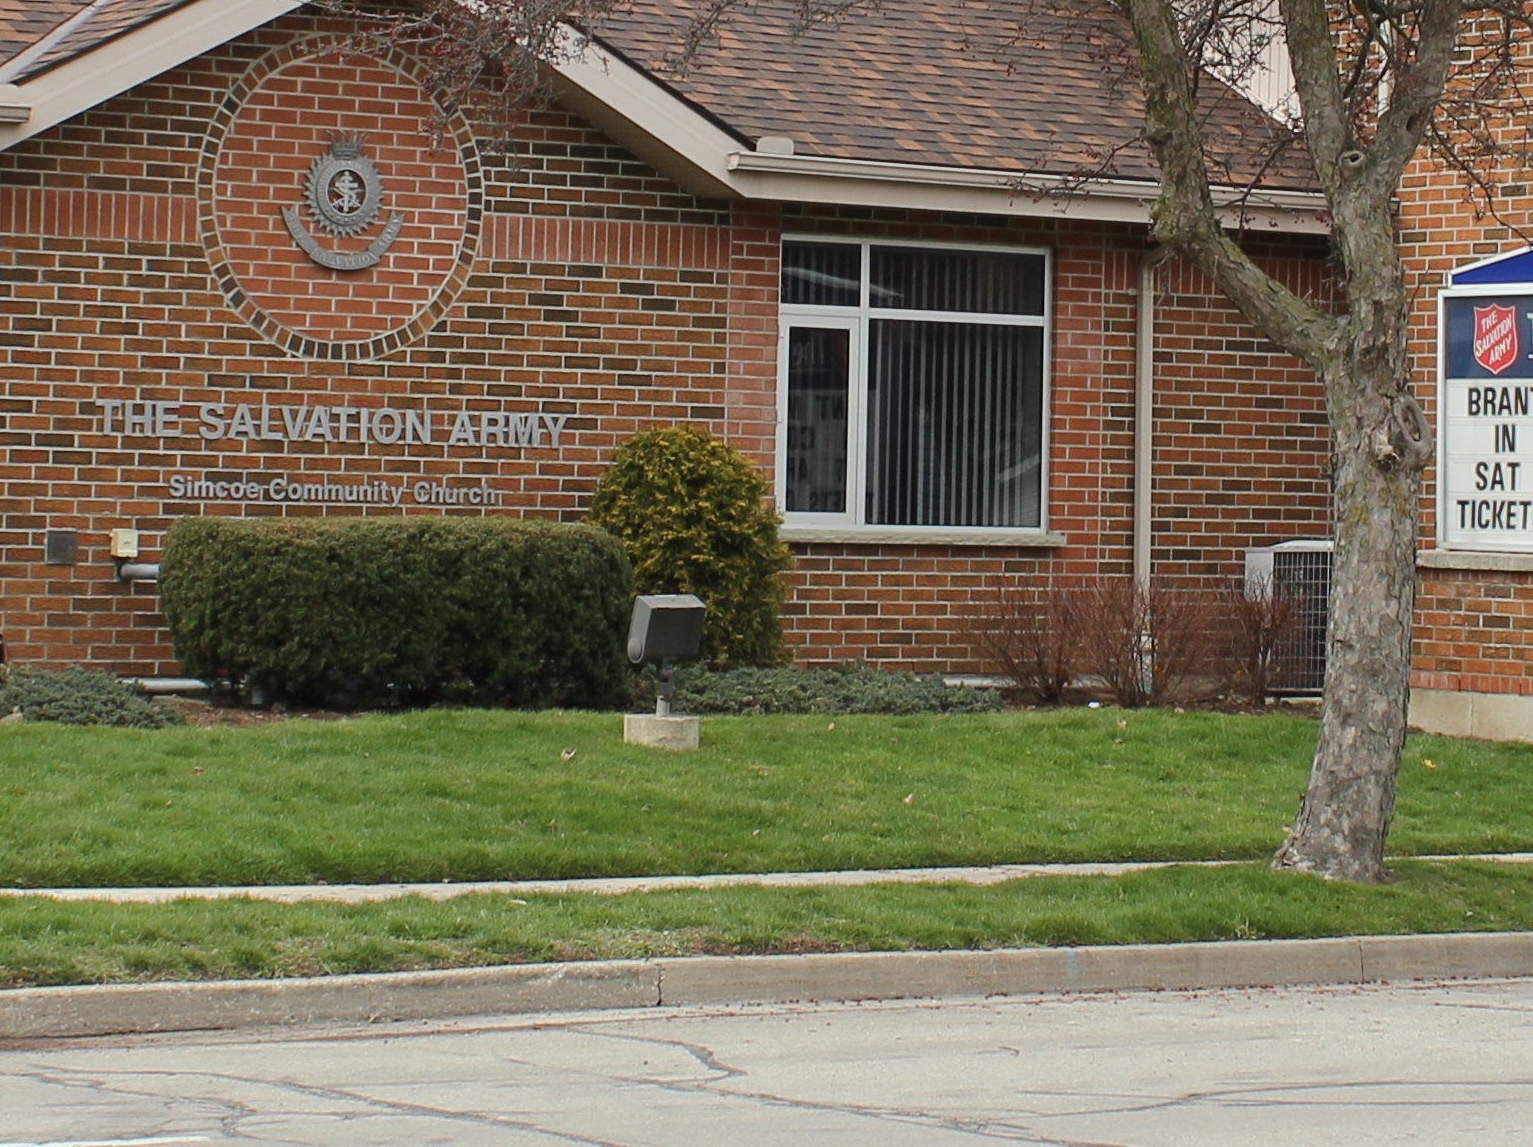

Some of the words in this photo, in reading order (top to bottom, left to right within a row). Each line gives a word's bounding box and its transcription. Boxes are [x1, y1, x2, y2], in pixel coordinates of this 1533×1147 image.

[1475, 313, 1513, 358] SALVATION
[1481, 310, 1498, 334] THE
[1488, 333, 1513, 366] ARMY
[95, 399, 182, 438] THE
[198, 403, 432, 445] SALVATION
[447, 410, 568, 449] ARMY
[1494, 423, 1517, 454] IN
[168, 474, 260, 498] Simcoe
[268, 477, 404, 508] Community
[413, 481, 497, 504] Church
[1474, 461, 1521, 492] SAT
